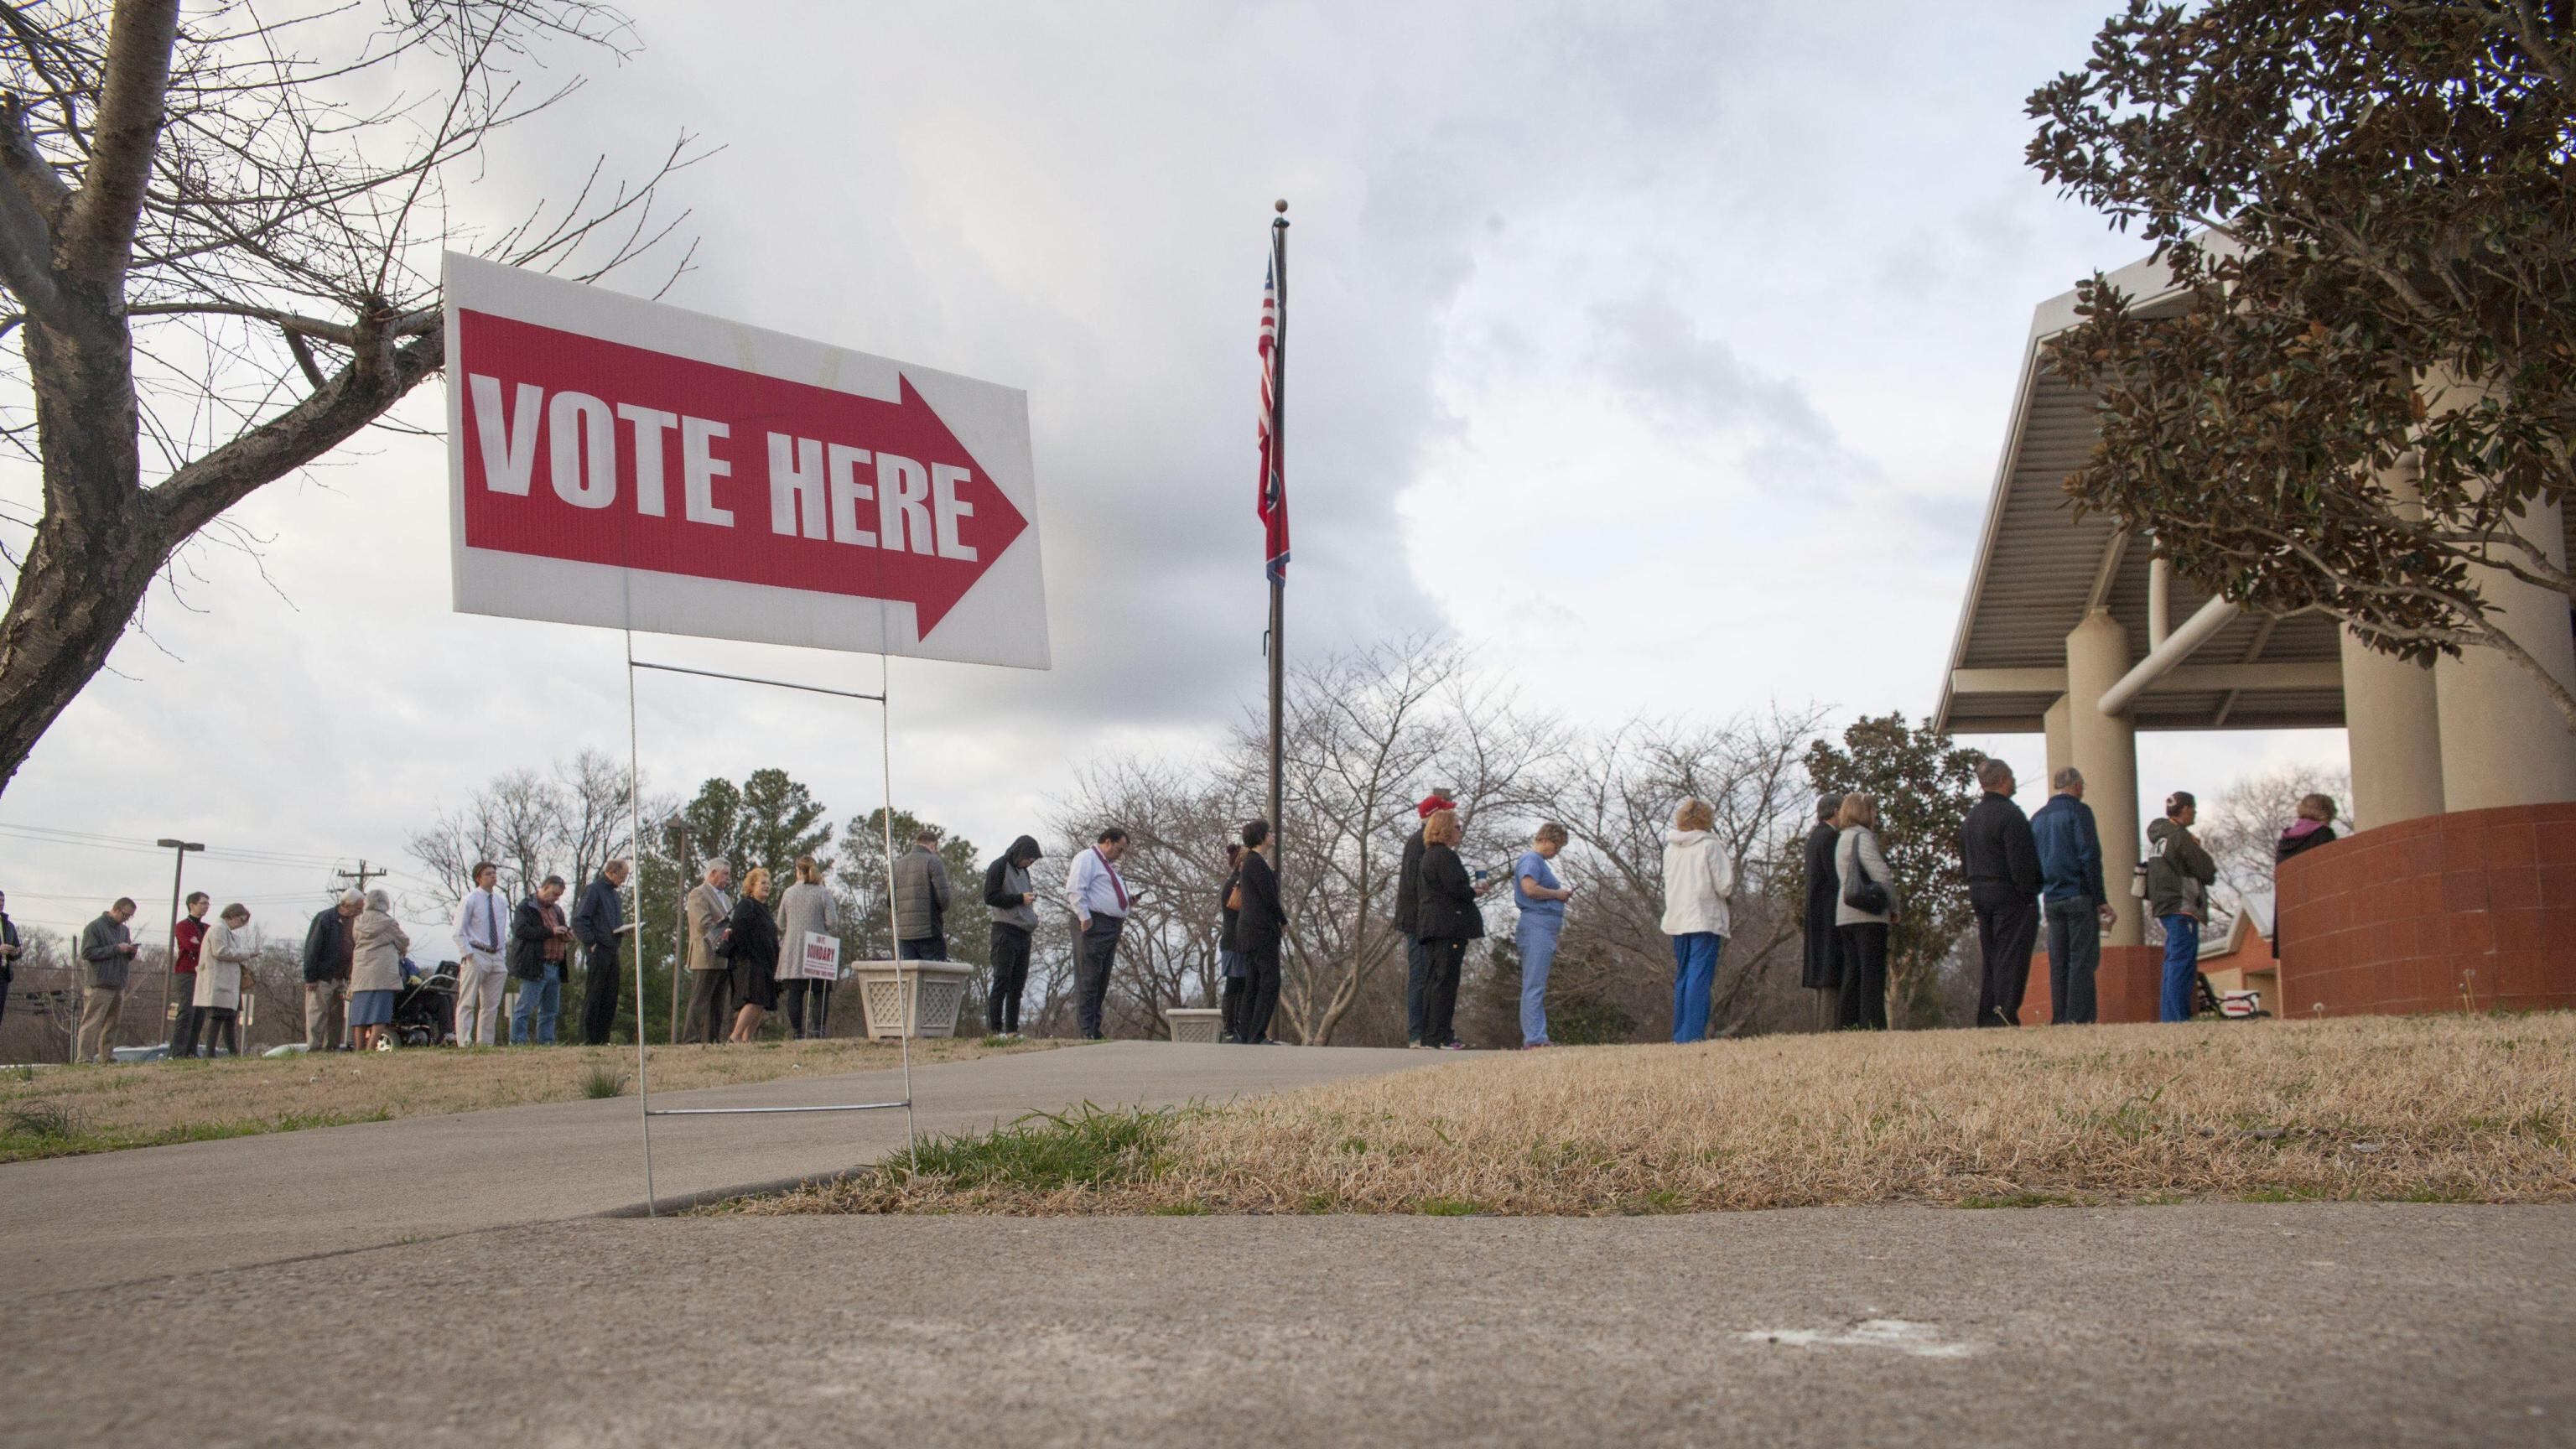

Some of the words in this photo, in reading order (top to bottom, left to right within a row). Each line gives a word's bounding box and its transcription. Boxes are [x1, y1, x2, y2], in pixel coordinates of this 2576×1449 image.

[469, 373, 735, 527] VOTE
[766, 432, 978, 562] HERE
[807, 943, 835, 962] BOUNDARY
